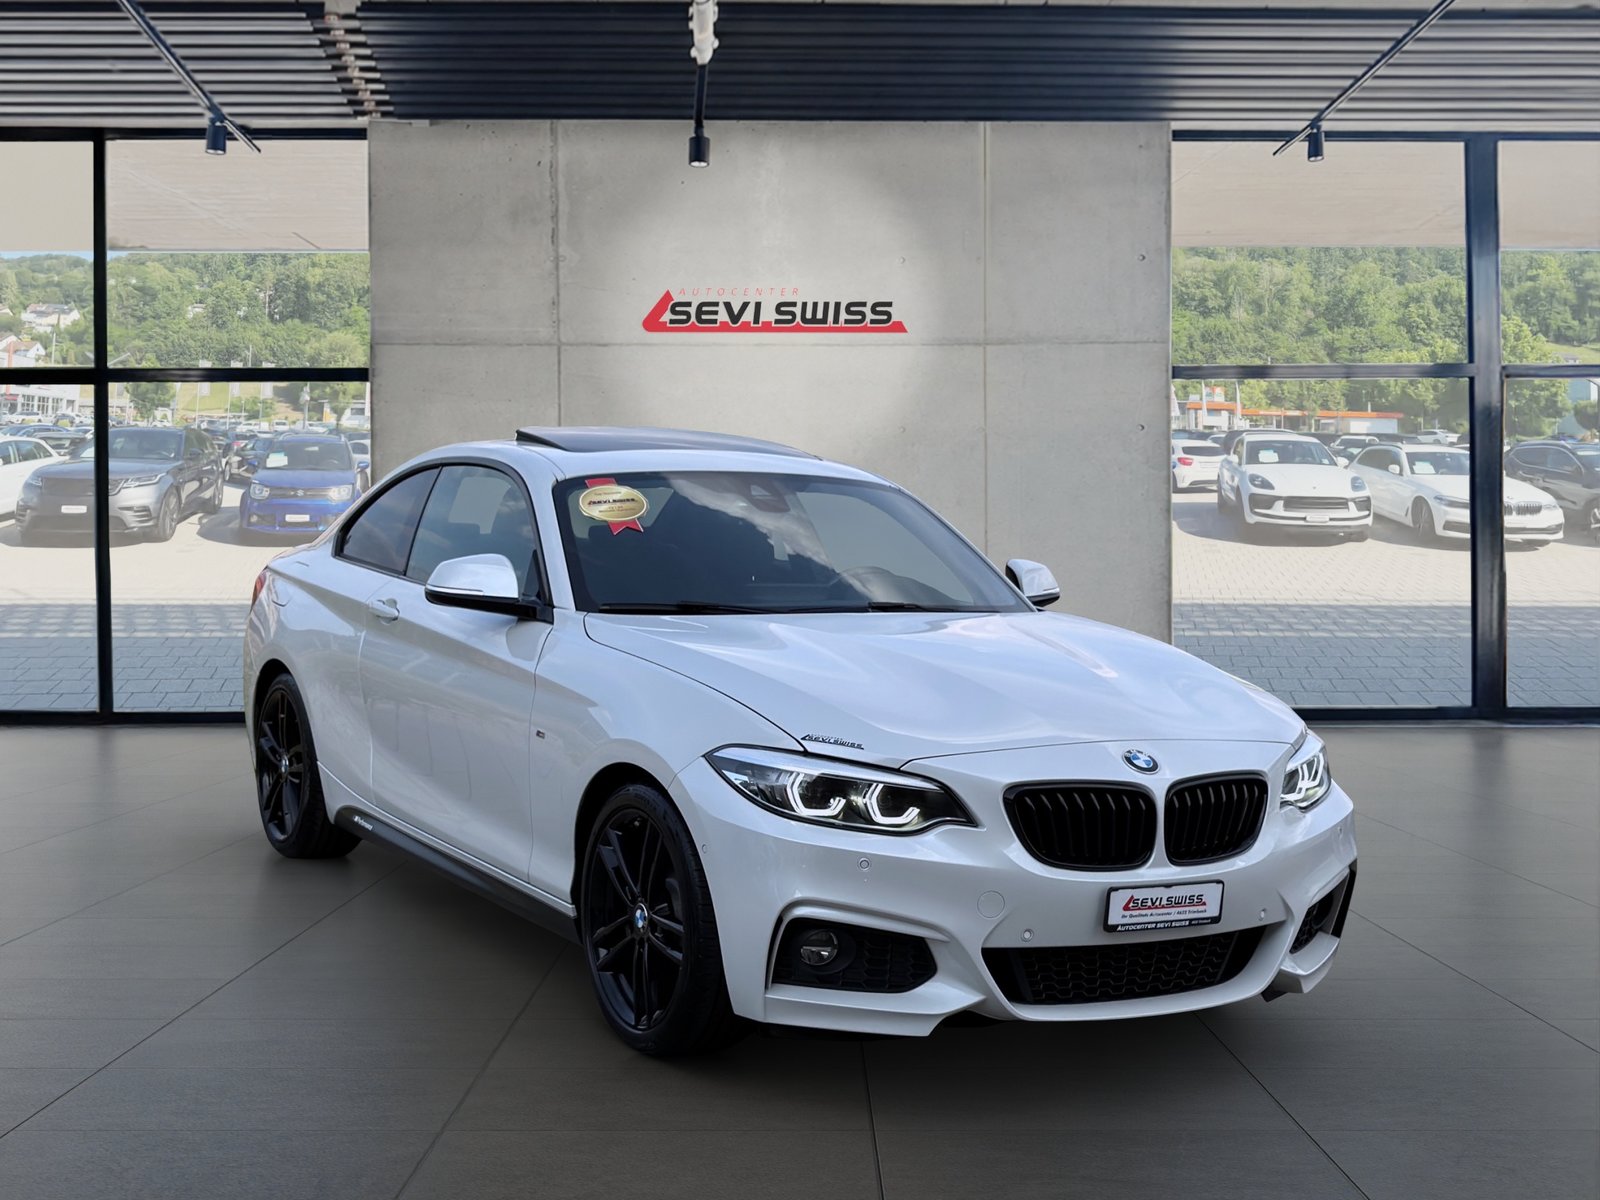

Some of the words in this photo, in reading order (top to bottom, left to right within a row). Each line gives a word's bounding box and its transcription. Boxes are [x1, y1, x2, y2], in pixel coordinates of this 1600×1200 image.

[679, 287, 800, 296] AUTOCENTER
[668, 301, 762, 325] SEVI
[773, 301, 893, 325] SWISS
[1131, 897, 1162, 908] SEVI
[1165, 894, 1204, 906] SWISS
